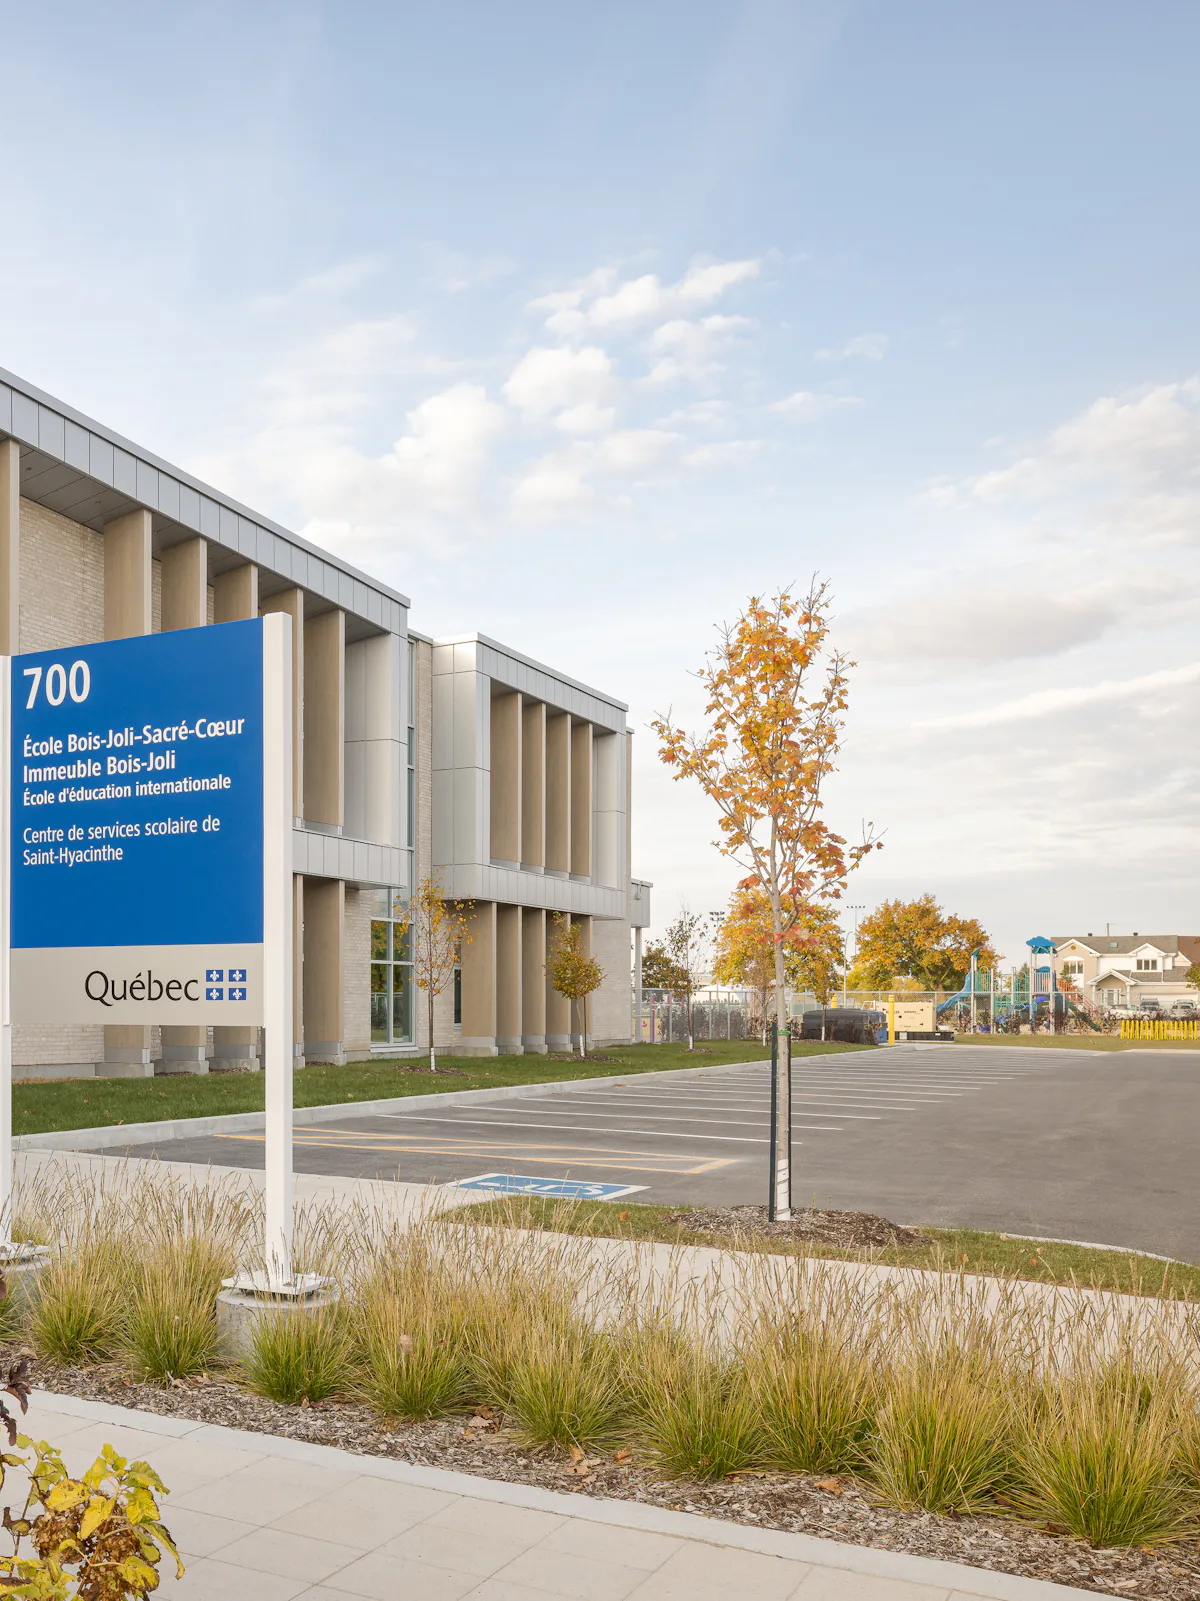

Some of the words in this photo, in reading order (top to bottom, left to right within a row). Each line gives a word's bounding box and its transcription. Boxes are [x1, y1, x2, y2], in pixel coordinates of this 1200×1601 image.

[23, 660, 90, 709] 700
[23, 734, 63, 757] École
[23, 758, 101, 783] Immeuble
[106, 750, 176, 775] Bois-Joli
[23, 786, 55, 806] École
[58, 783, 132, 803] d'éducation
[135, 774, 231, 797] internationale
[23, 826, 65, 844] Centre
[67, 824, 84, 841] de
[87, 820, 141, 839] services
[144, 816, 198, 836] scolaire
[202, 814, 221, 832] de
[23, 844, 124, 867] Saint-Hyacinthe
[84, 970, 200, 1007] Québec
